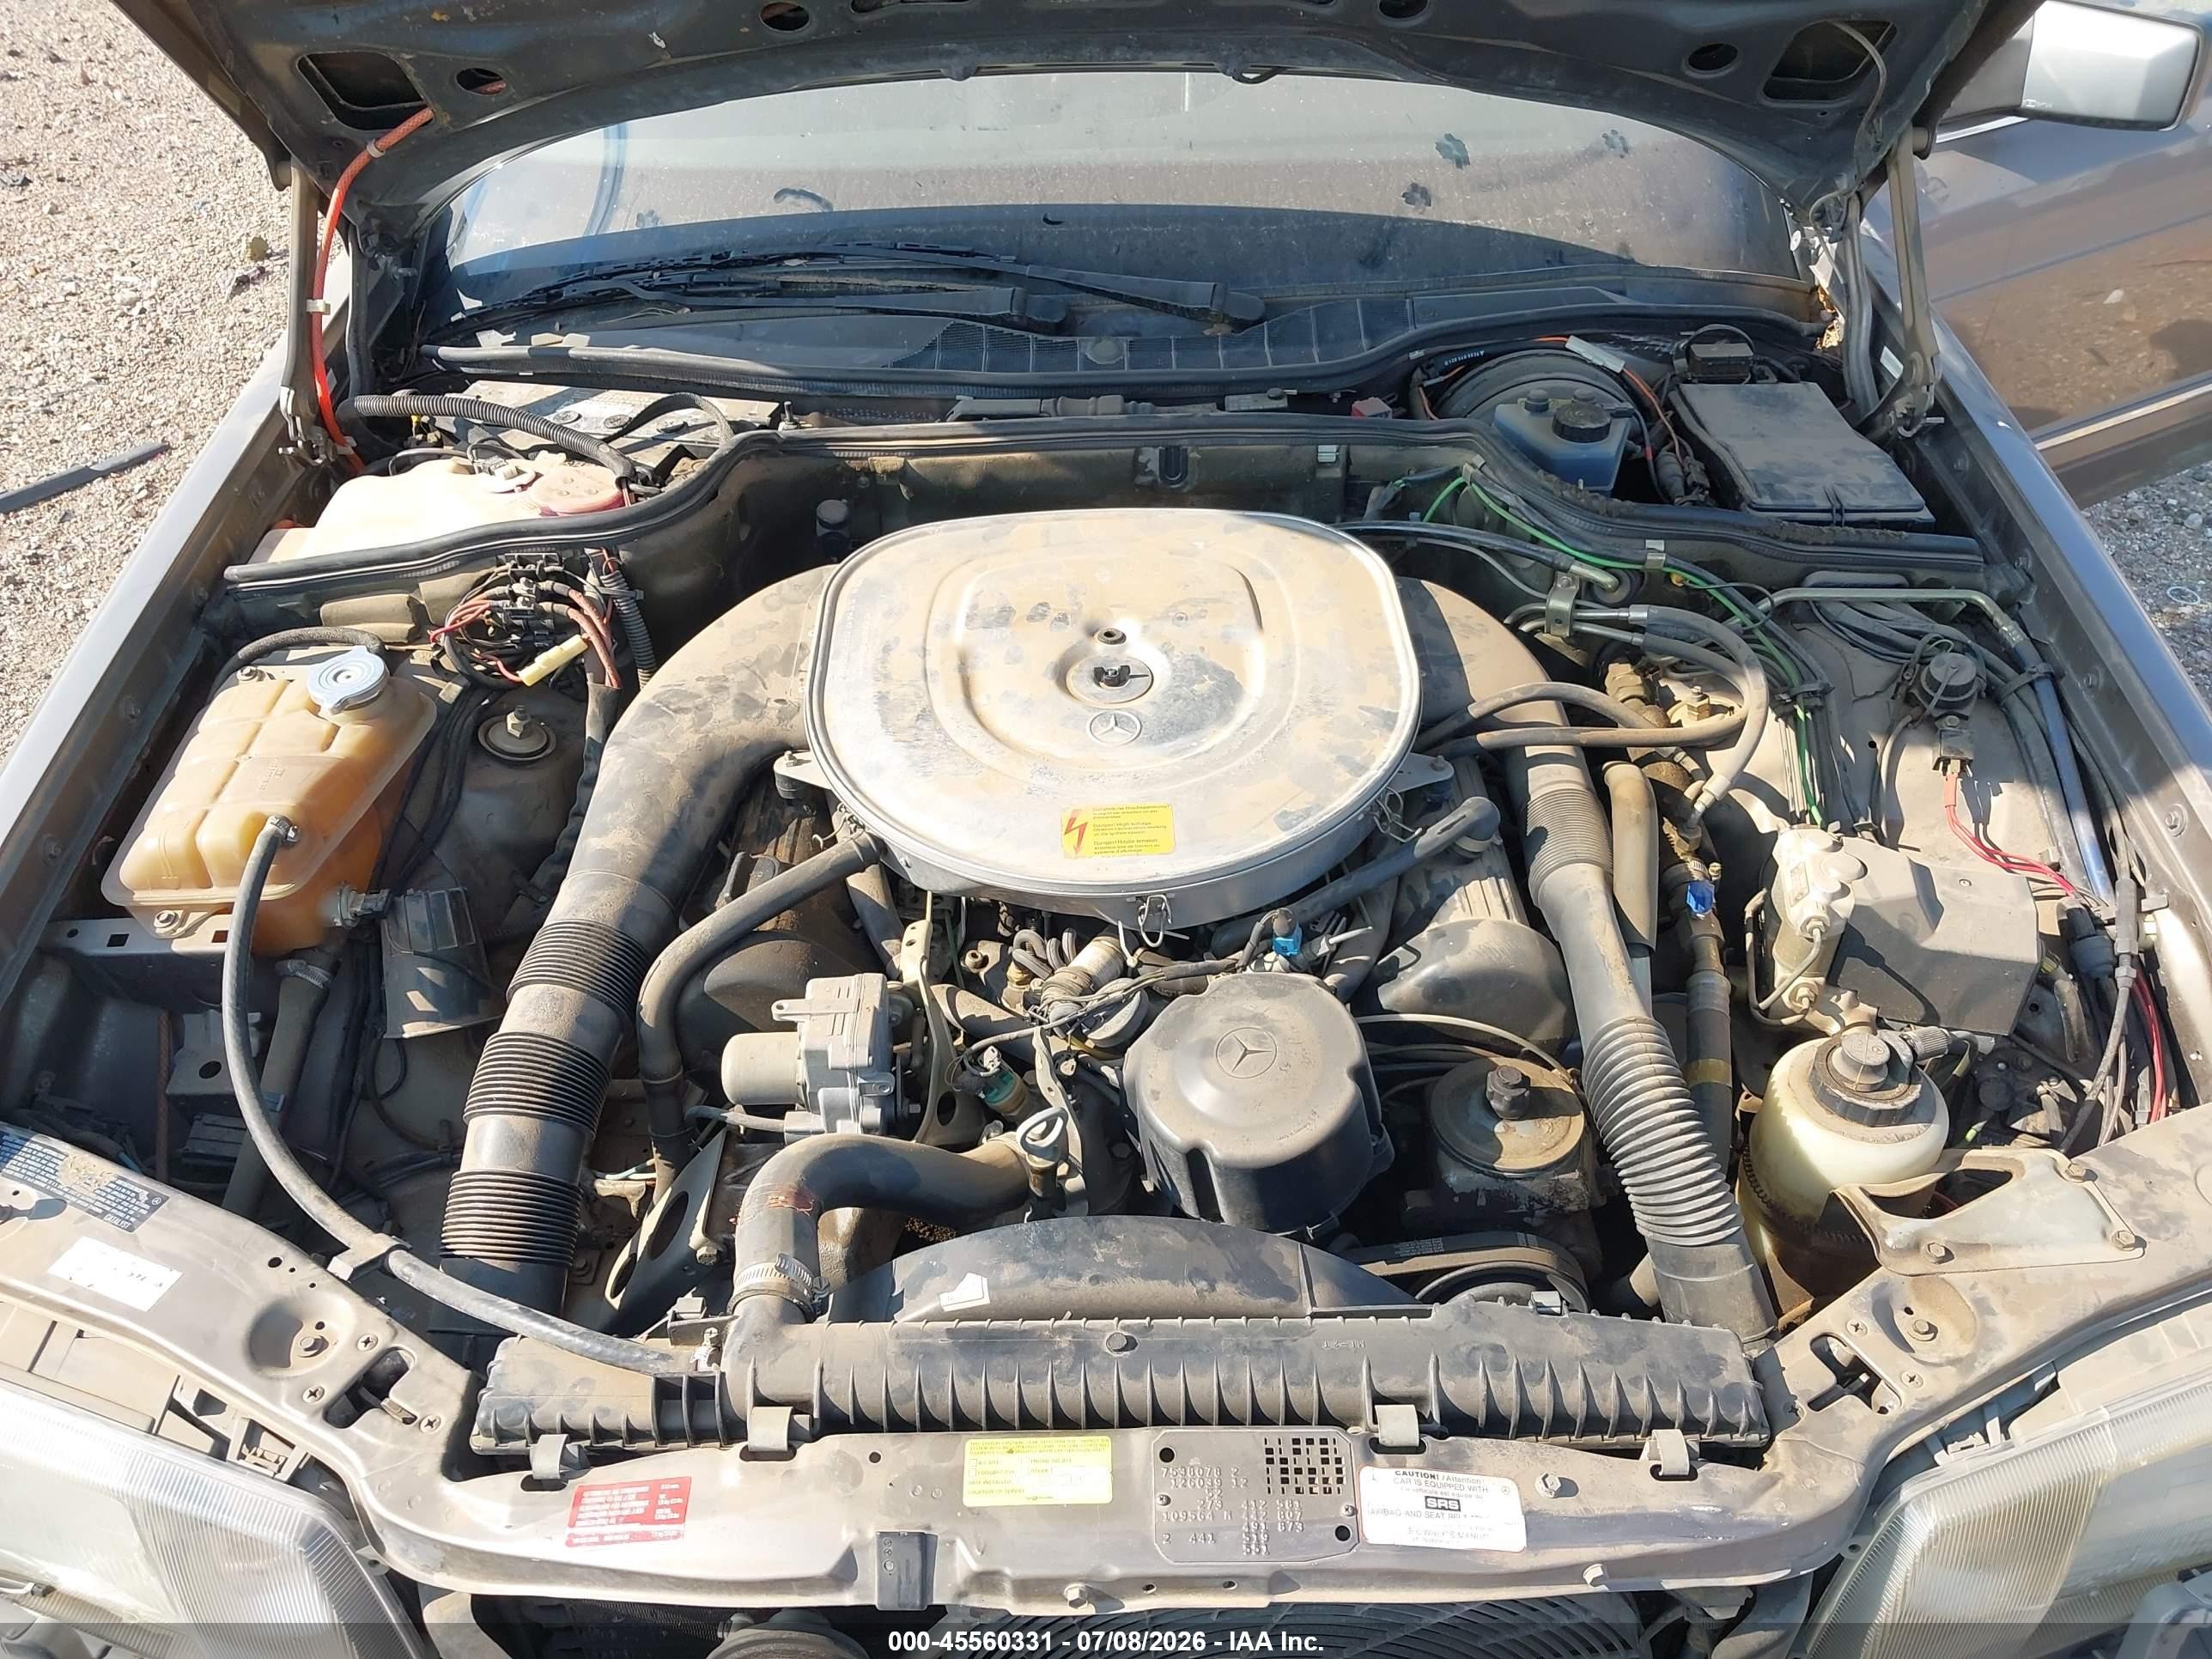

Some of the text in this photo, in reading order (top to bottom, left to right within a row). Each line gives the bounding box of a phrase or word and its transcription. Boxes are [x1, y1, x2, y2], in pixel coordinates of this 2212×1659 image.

[1231, 1467, 1240, 1478] 2
[1395, 1469, 1439, 1480] CAUTION!
[1231, 1477, 1249, 1489] 12
[1394, 1477, 1412, 1486] CAR
[1425, 1480, 1465, 1492] EQUIPPED
[1468, 1485, 1488, 1493] WITH
[1242, 1499, 1268, 1510] 412
[1426, 1498, 1460, 1510] SRS
[1278, 1510, 1303, 1521] 807
[1243, 1521, 1269, 1533] 491
[1161, 1532, 1216, 1545] 2 441
